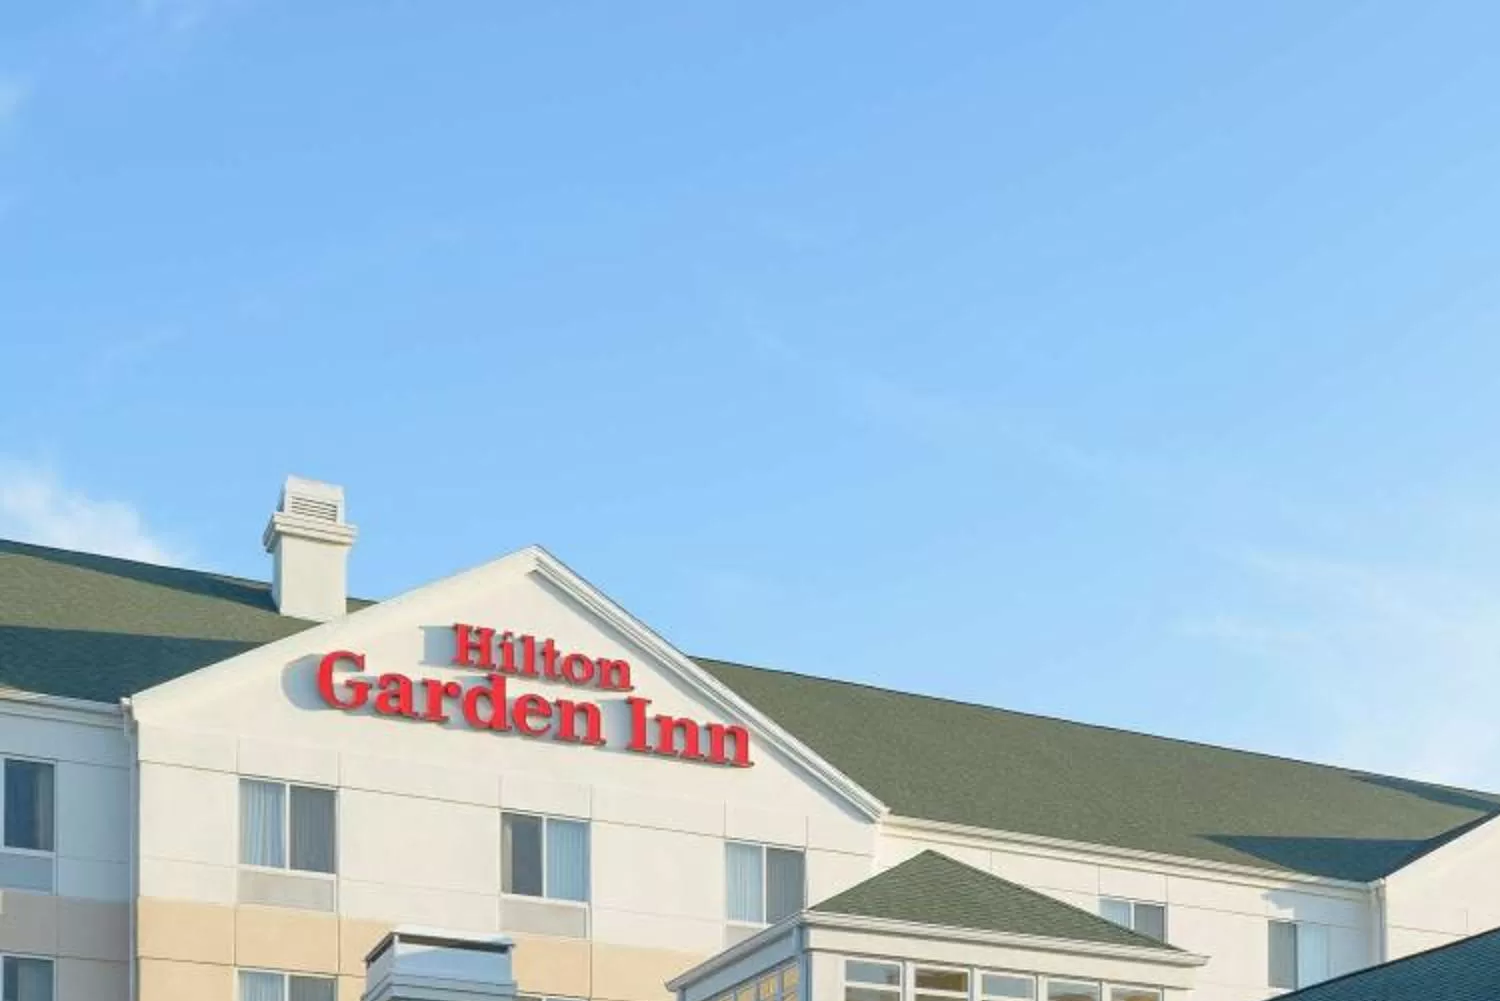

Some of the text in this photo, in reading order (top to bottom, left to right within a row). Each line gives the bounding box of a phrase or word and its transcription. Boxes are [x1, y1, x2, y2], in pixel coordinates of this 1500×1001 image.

[452, 623, 634, 692] Hilton
[315, 650, 754, 768] Garden Inn
